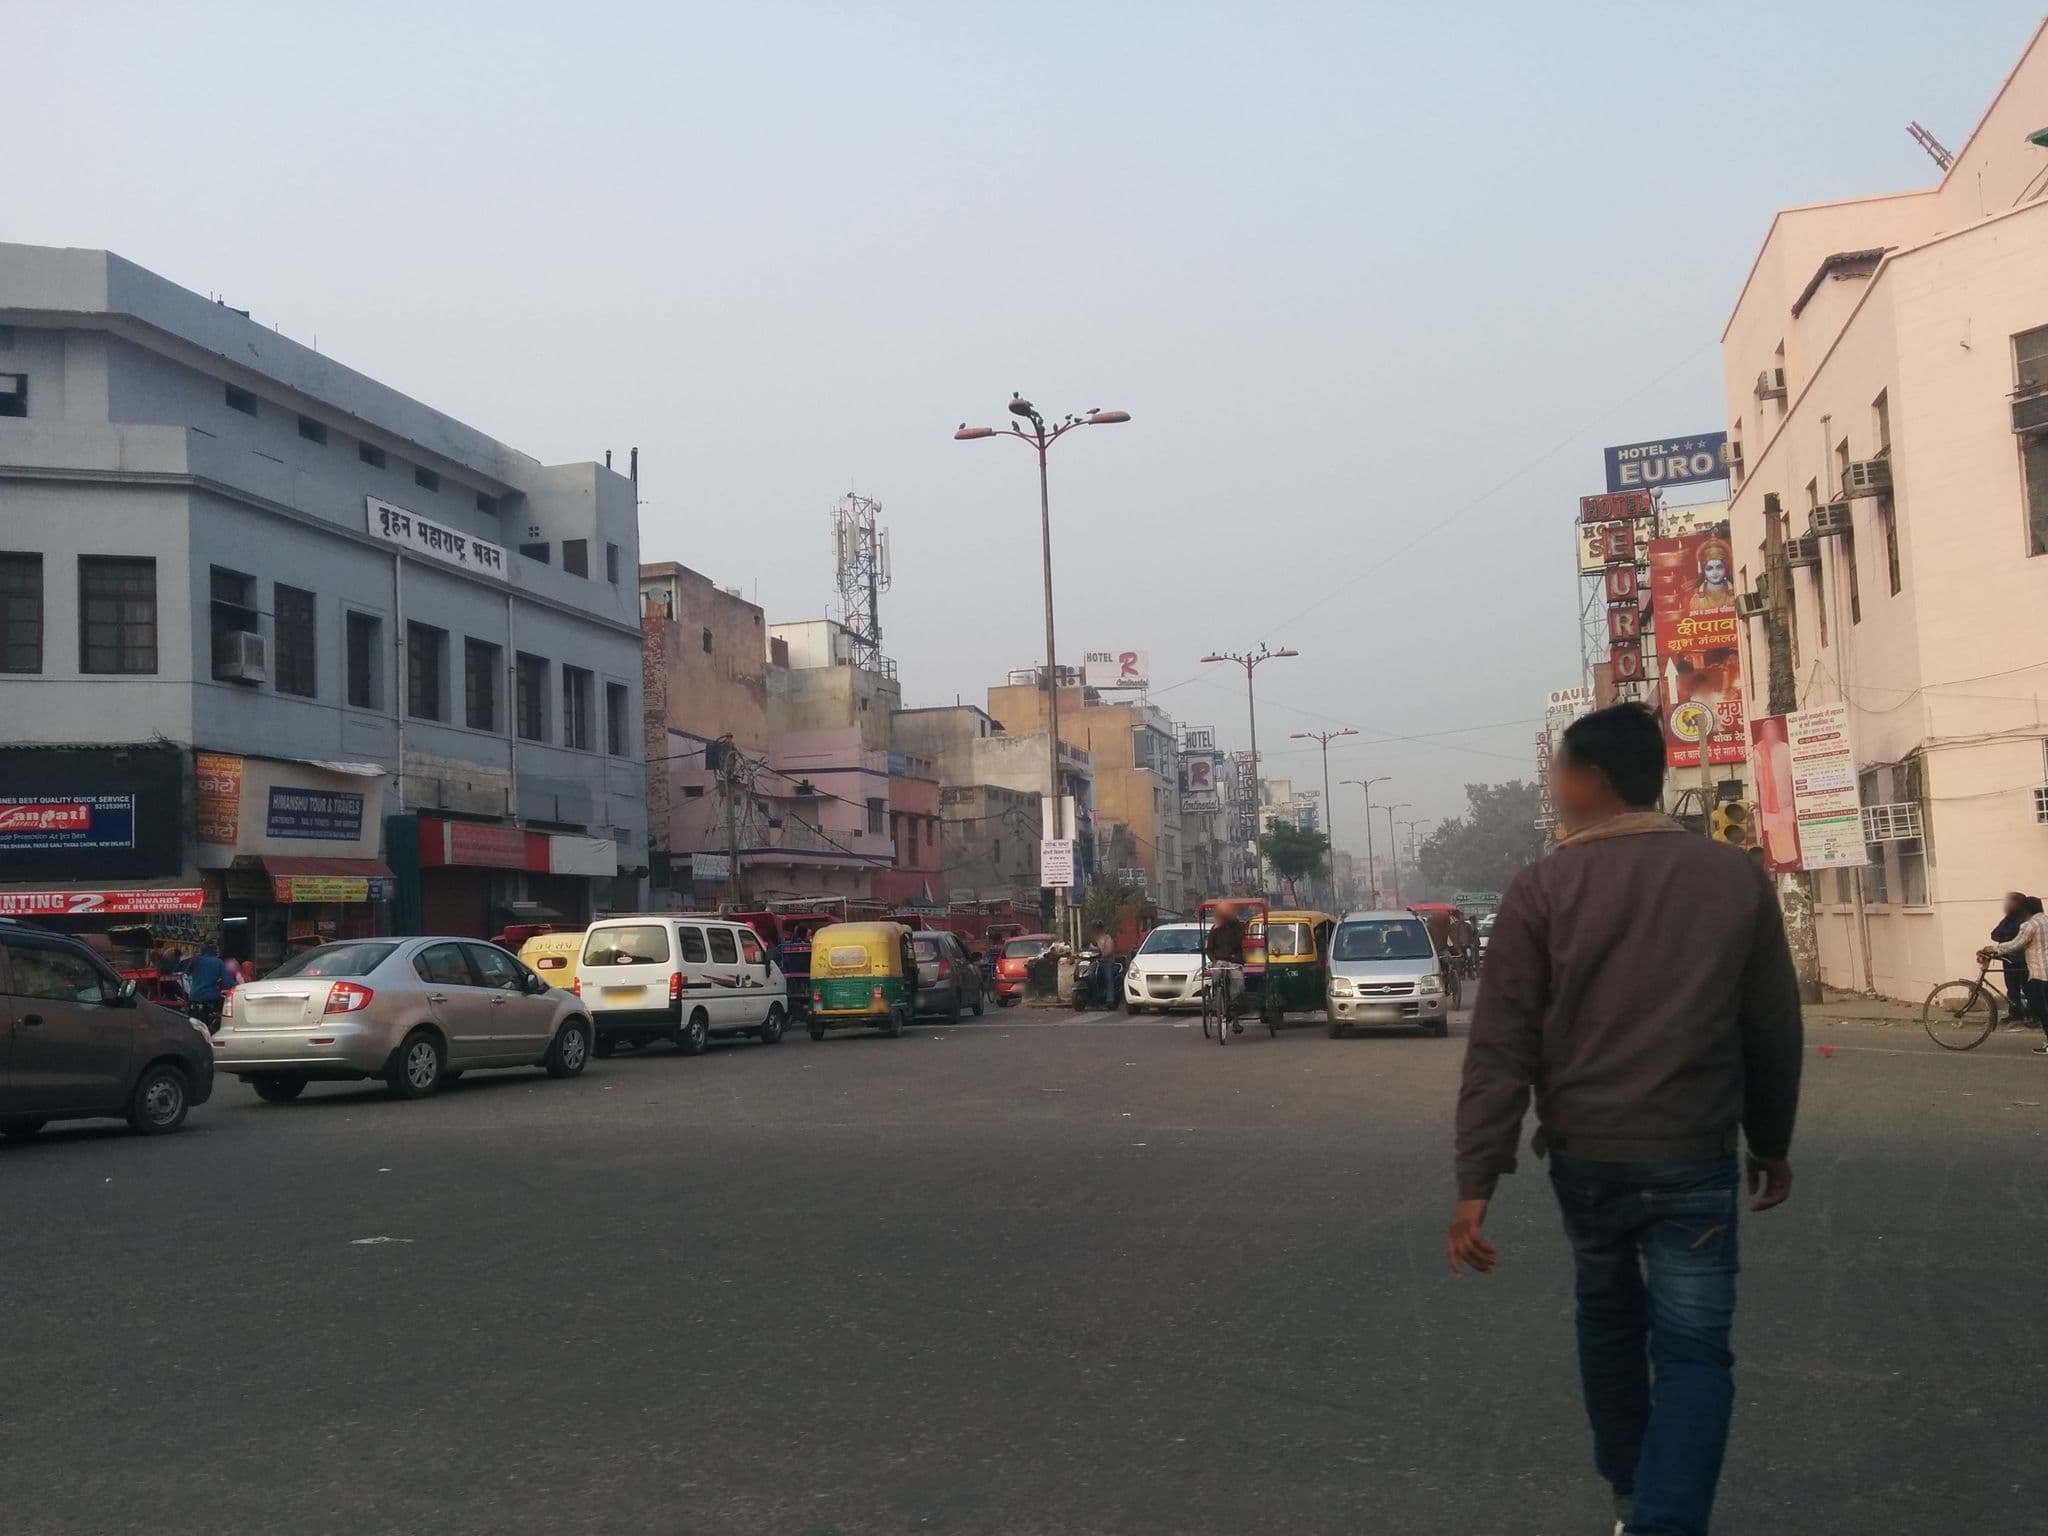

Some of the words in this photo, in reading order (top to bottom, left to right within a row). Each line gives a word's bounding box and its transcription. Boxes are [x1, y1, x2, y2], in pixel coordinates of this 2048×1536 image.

[1618, 445, 1667, 461] HOTEL
[1620, 453, 1714, 486] EURO
[1584, 494, 1649, 518] HOTEL
[472, 543, 500, 570] भवन
[1609, 531, 1636, 678] EURO
[1677, 617, 1737, 636] दीपाव
[1087, 652, 1113, 663] HOTEL
[1119, 651, 1138, 677] R
[1186, 730, 1213, 748] HOTEL
[1191, 762, 1210, 786] R
[200, 777, 235, 793] फोटो
[40, 796, 71, 804] QUALITY
[310, 798, 327, 813] TOUR
[334, 799, 361, 815] TRAVELS
[69, 894, 106, 913] 2
